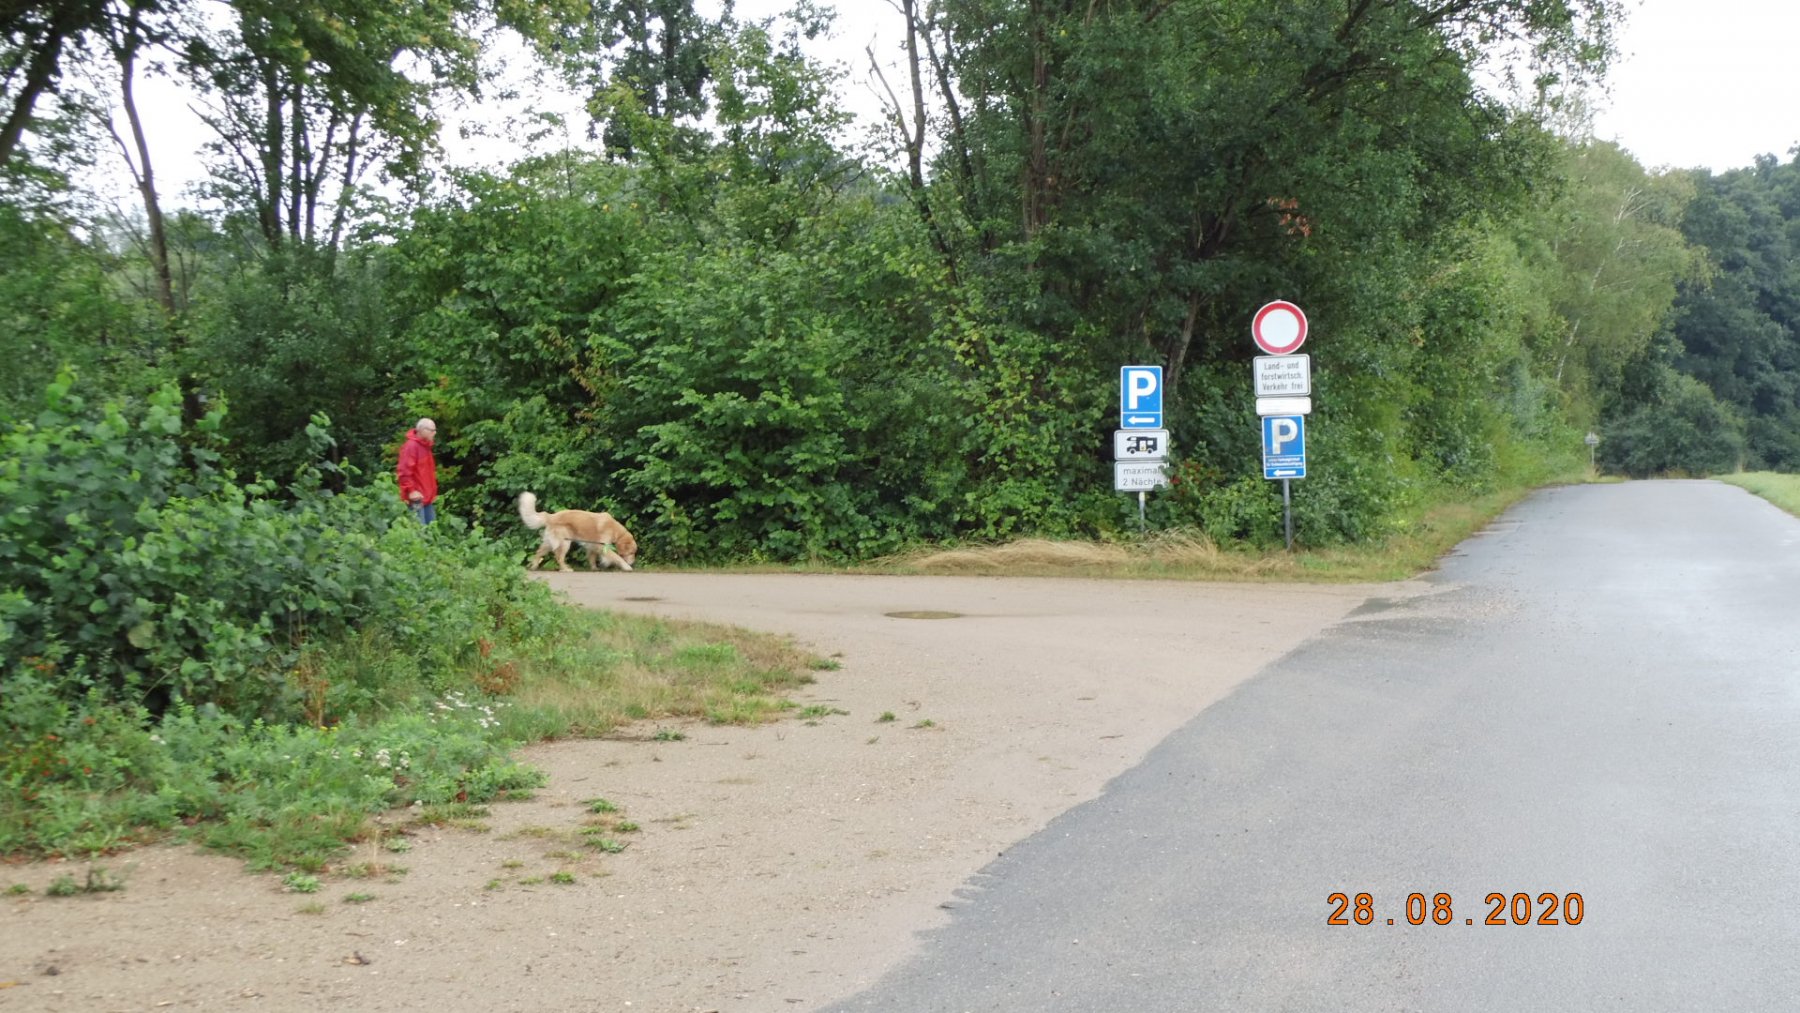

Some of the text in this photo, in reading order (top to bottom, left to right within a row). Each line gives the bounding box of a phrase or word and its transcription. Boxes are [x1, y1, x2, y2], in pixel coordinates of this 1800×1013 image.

[1264, 361, 1299, 370] Land- und
[1129, 370, 1157, 410] P
[1262, 382, 1303, 391] Verkehr frei
[1271, 418, 1298, 455] P
[1122, 478, 1128, 486] 2
